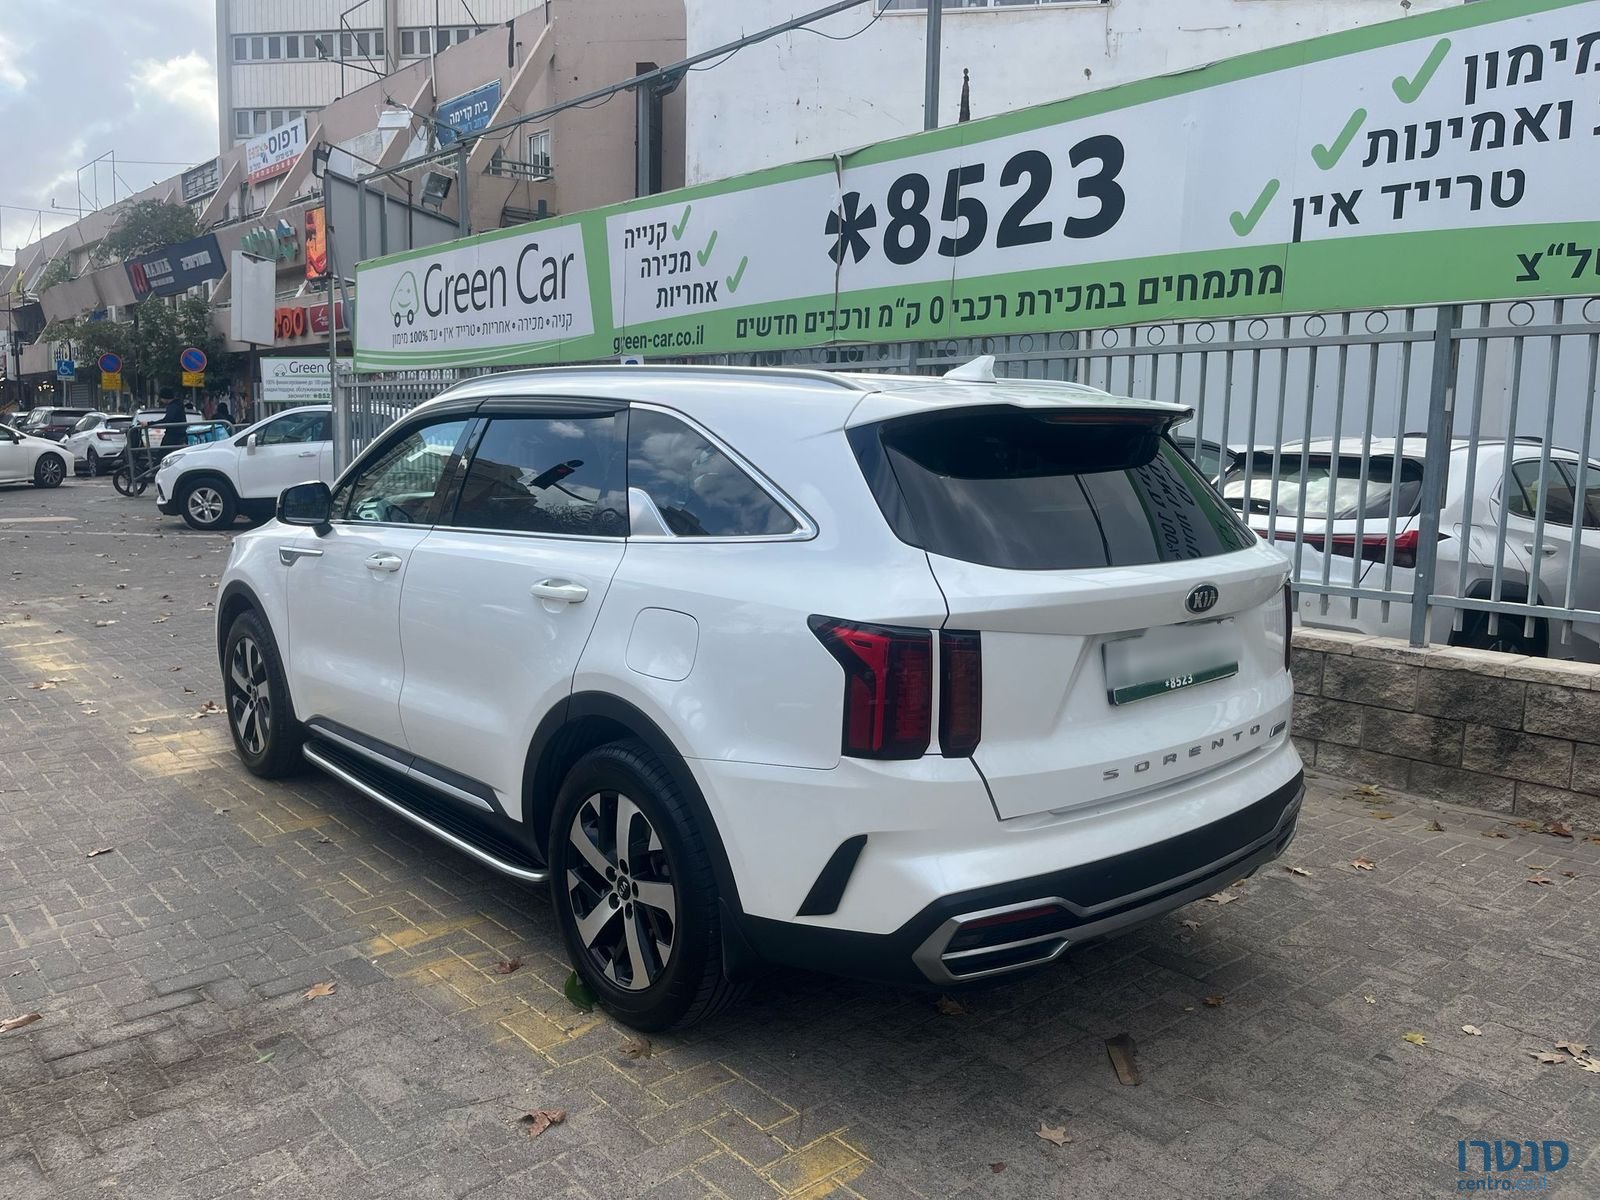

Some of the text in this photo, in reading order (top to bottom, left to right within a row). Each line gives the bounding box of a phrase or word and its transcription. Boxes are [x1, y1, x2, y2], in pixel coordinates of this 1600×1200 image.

[449, 105, 473, 125] קדימה
[474, 101, 488, 115] בית
[268, 124, 299, 155] דפוס
[1361, 101, 1575, 168] ואמינות
[1292, 168, 1526, 243] טרייד אין
[624, 221, 668, 250] קנייה
[640, 250, 692, 279] מכירה
[1515, 242, 1600, 283] ל"צ
[423, 243, 575, 317] Green Car
[1137, 264, 1284, 305] מתמחים
[656, 280, 719, 309] אחריות
[951, 294, 1007, 322] רכבי
[1015, 281, 1127, 317] במכירת
[517, 316, 544, 332] מכירה
[551, 312, 573, 332] קניה
[804, 306, 871, 333] ורכבים
[929, 296, 944, 324] 0
[410, 329, 428, 344] 100%
[455, 324, 476, 338] טרייד
[482, 319, 511, 336] אחריות
[613, 324, 704, 354] green-car.co.il
[736, 313, 798, 339] חדשים
[289, 361, 324, 373] Green
[1192, 590, 1218, 608] KIA
[1102, 724, 1260, 781] SORENTO
